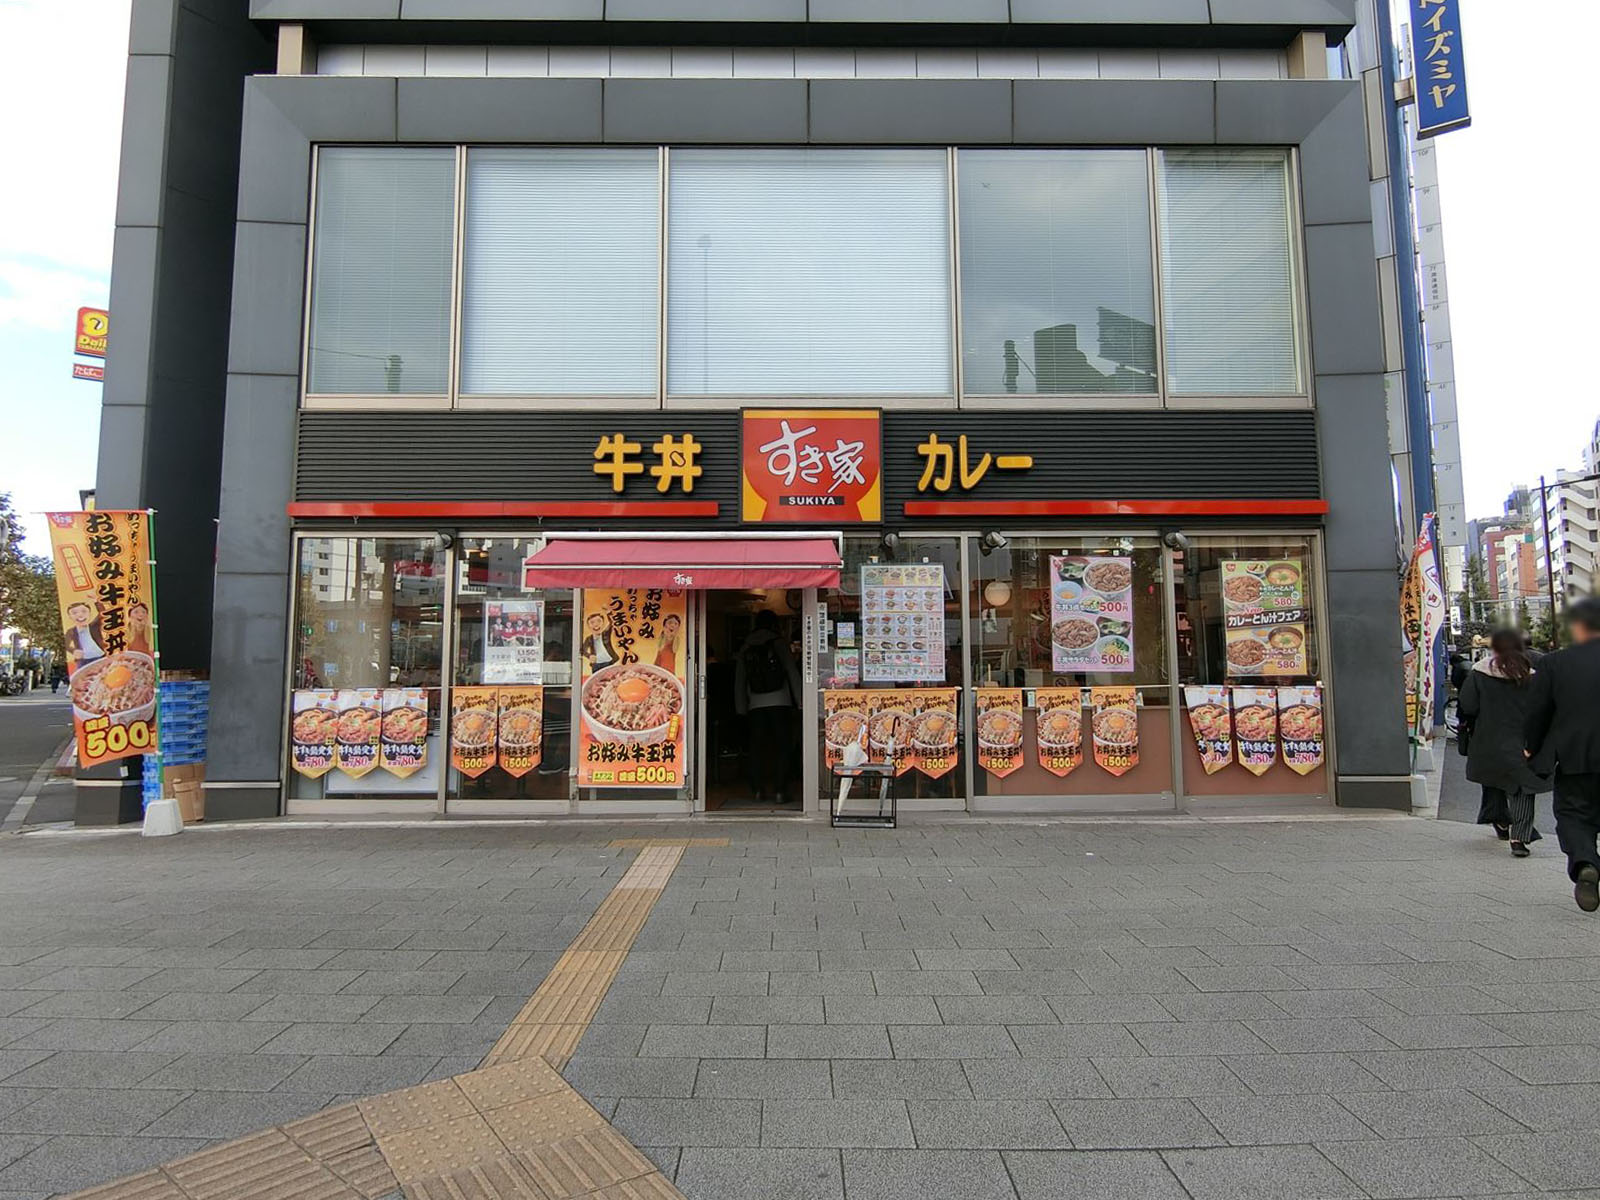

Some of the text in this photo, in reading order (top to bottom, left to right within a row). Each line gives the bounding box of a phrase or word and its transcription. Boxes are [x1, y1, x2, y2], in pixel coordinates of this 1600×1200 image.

[593, 433, 702, 493] 牛丼
[760, 419, 865, 494] すき家
[918, 433, 1033, 492] カレー
[788, 496, 836, 506] SUKIYA
[86, 512, 127, 656] お好み牛玉丼
[673, 572, 693, 586] すき家
[610, 596, 639, 666] うまいやん
[639, 588, 662, 638] お好み
[1228, 610, 1301, 627] カレーとん汁フェア
[587, 742, 676, 763] お好み牛玉丼
